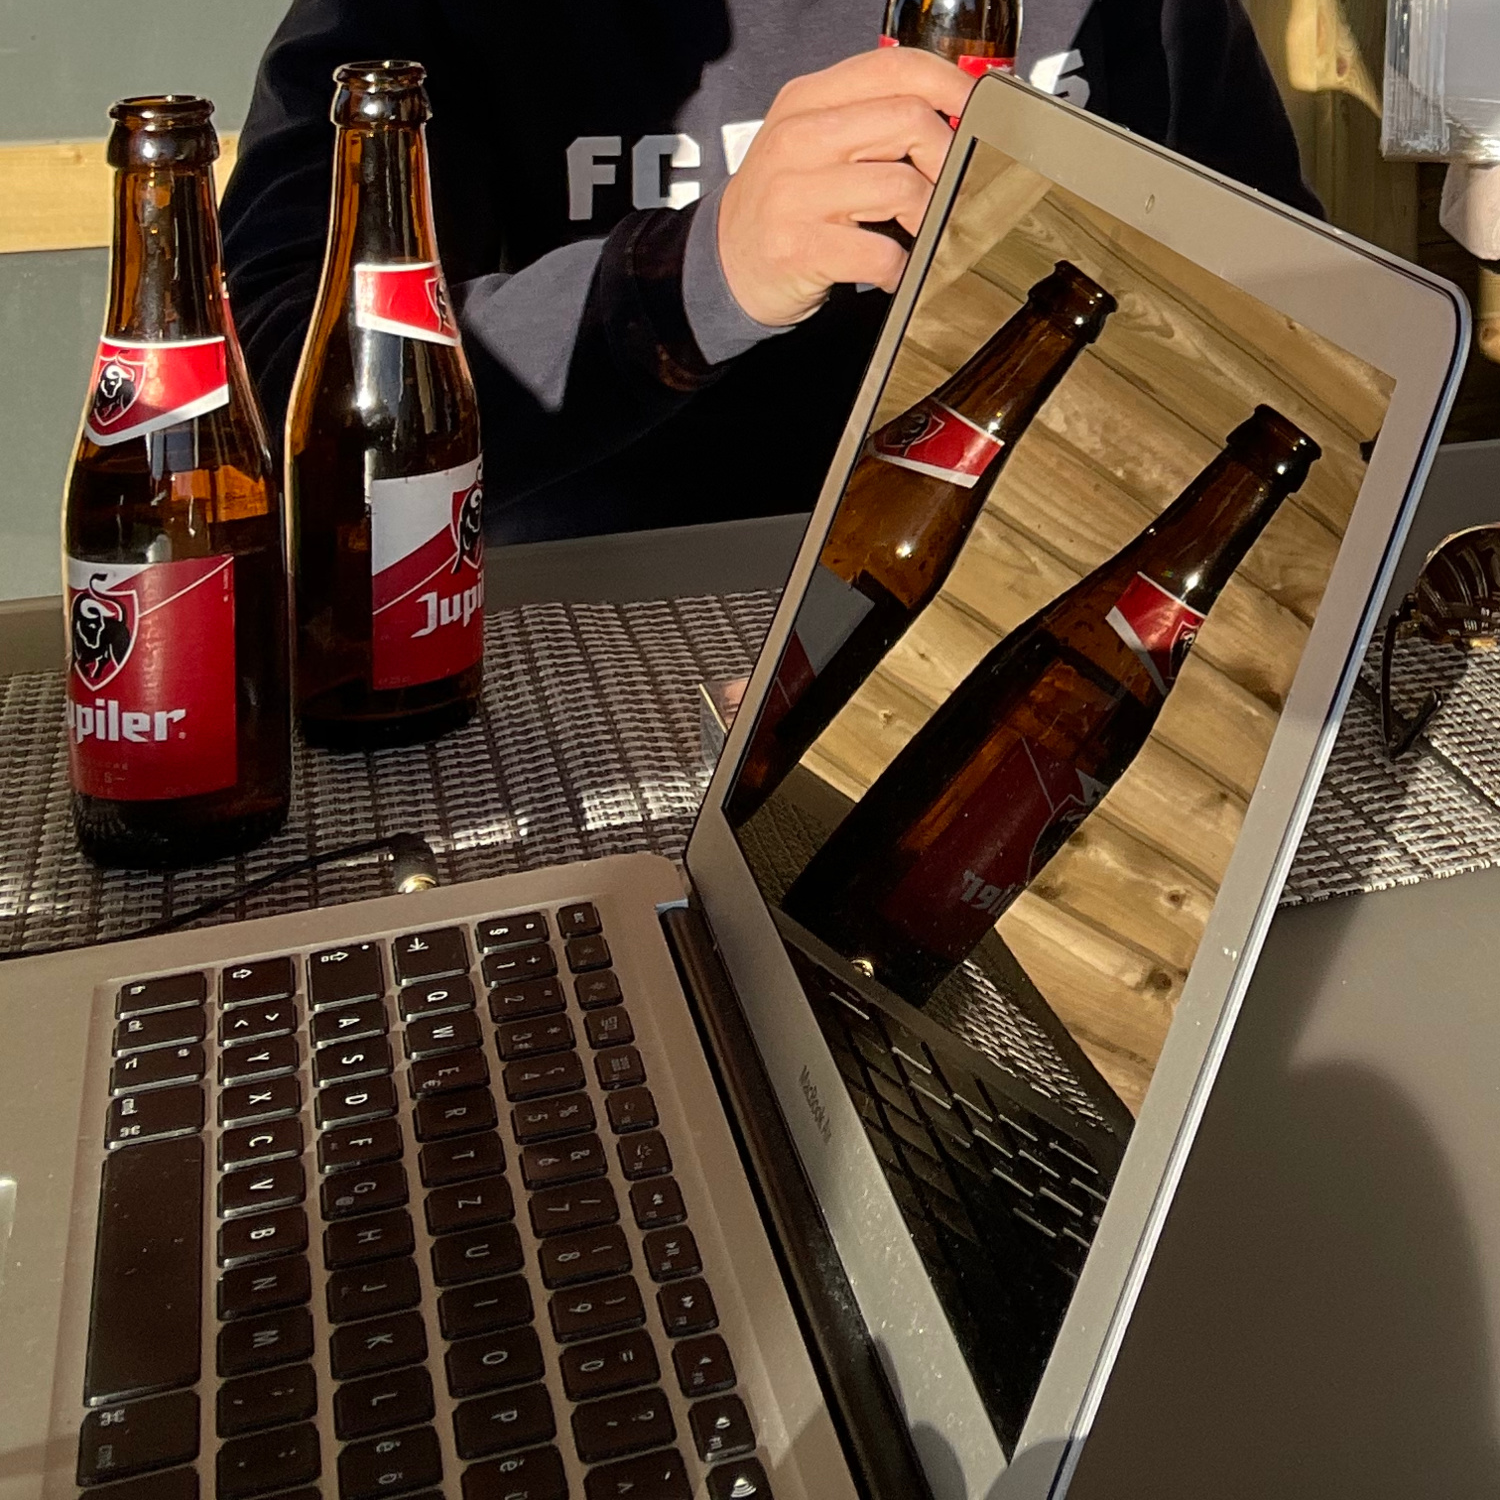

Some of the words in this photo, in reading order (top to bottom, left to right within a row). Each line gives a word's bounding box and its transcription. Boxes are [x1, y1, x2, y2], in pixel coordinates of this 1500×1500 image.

[565, 133, 701, 221] FC
[427, 990, 448, 1003] Q
[338, 1017, 361, 1028] A
[432, 1025, 454, 1039] W
[247, 1051, 270, 1062] Y
[341, 1054, 364, 1065] S
[438, 1066, 460, 1077] E
[249, 1091, 272, 1105] X
[345, 1093, 368, 1105] D
[444, 1107, 467, 1119] R
[249, 1135, 273, 1147] C
[349, 1137, 373, 1146] F
[452, 1150, 475, 1160] T
[249, 1178, 274, 1190] V
[353, 1181, 377, 1194] G
[457, 1195, 482, 1209] Z
[250, 1227, 276, 1240] B
[357, 1228, 381, 1244] H
[465, 1243, 490, 1258] U
[252, 1276, 277, 1291] N
[361, 1283, 387, 1292] J
[252, 1329, 279, 1349] M
[366, 1333, 394, 1350] K
[482, 1350, 508, 1365] O
[371, 1393, 396, 1406] L
[491, 1409, 518, 1422] P
